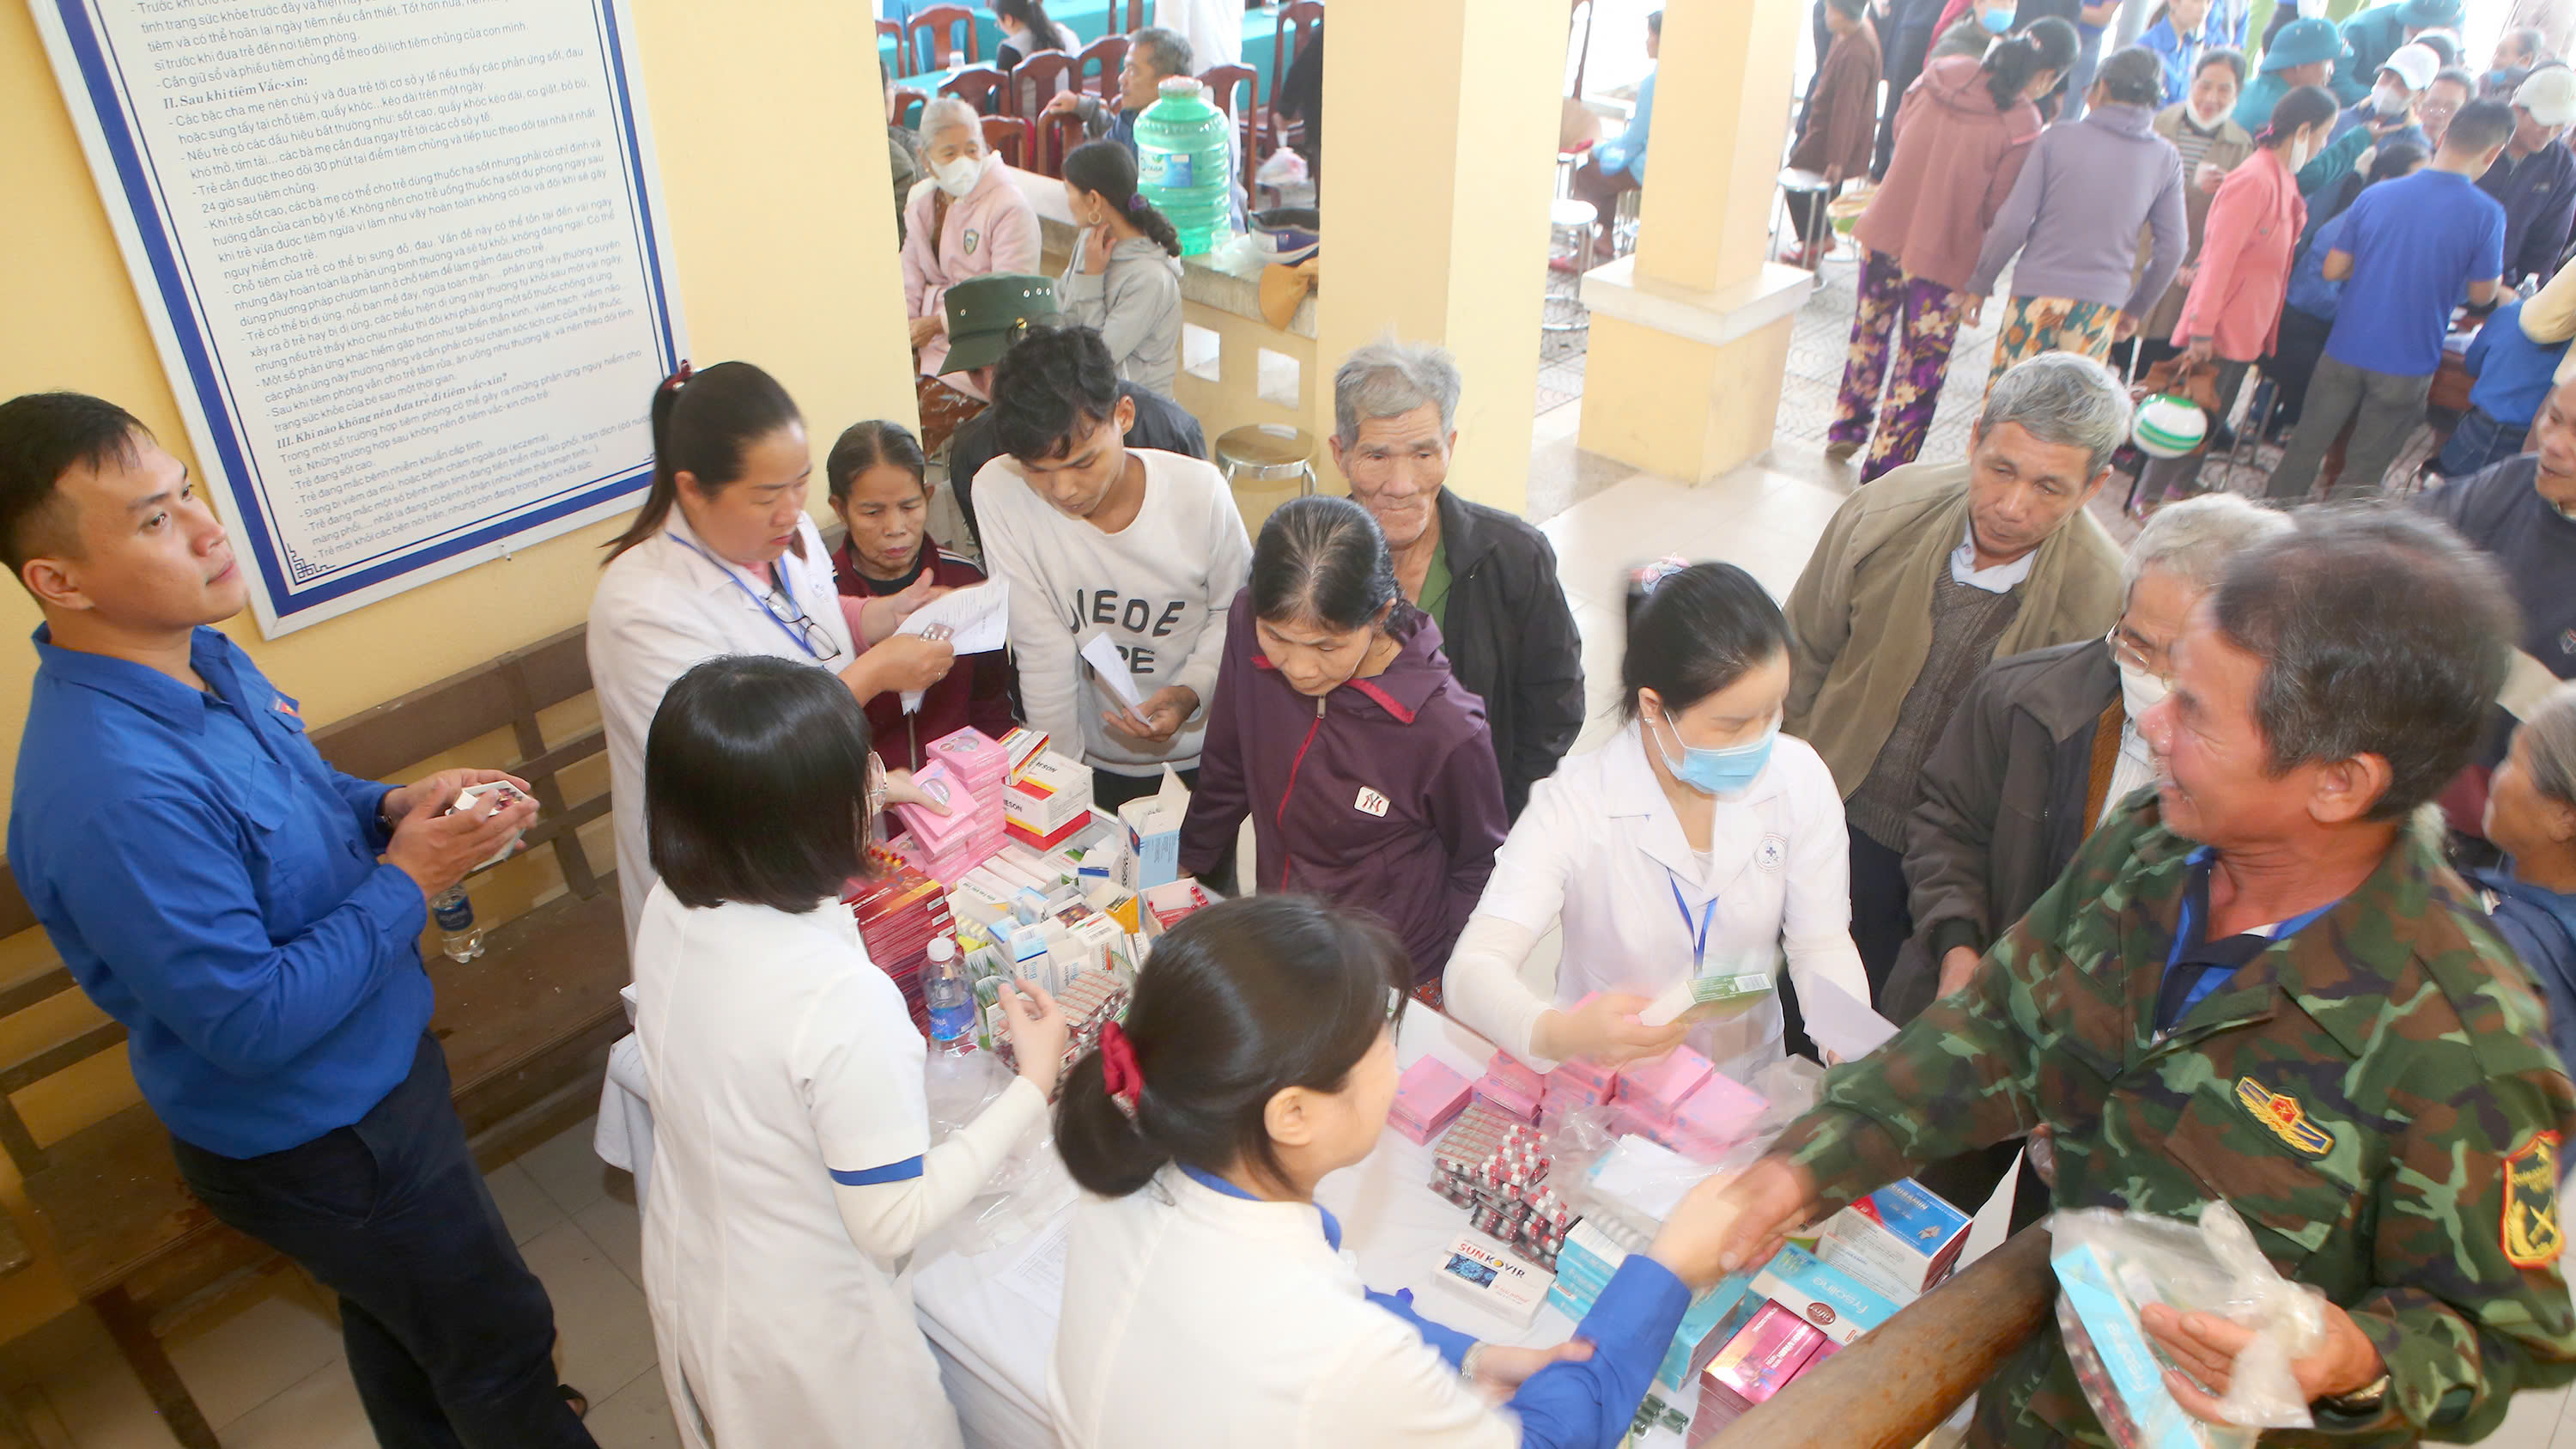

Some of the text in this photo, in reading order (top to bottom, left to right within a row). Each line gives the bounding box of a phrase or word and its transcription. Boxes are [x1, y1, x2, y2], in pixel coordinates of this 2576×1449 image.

[162, 96, 179, 109] II.
[179, 94, 204, 107] Sau
[205, 88, 227, 102] khi
[228, 85, 257, 98] tiêm
